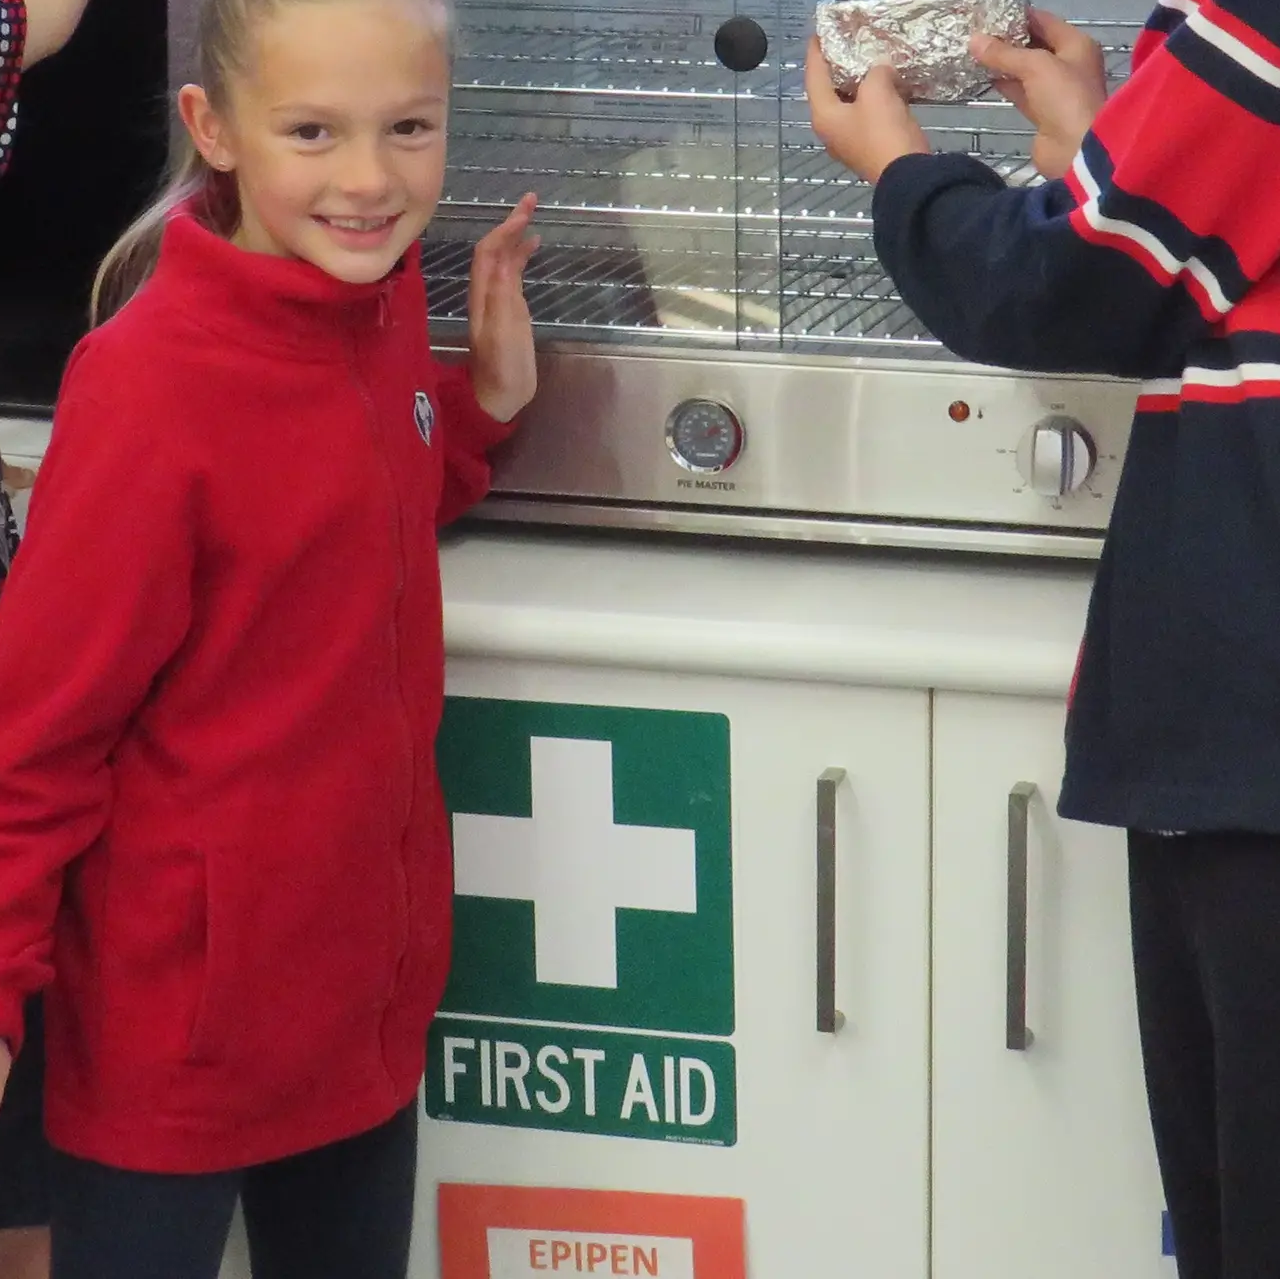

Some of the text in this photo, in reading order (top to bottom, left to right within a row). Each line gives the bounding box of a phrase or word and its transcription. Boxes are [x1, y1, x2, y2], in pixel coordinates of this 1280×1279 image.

[677, 479, 736, 491] PIE MASTER
[443, 1036, 716, 1127] FIRST AID
[528, 1239, 659, 1277] EPIPEN
